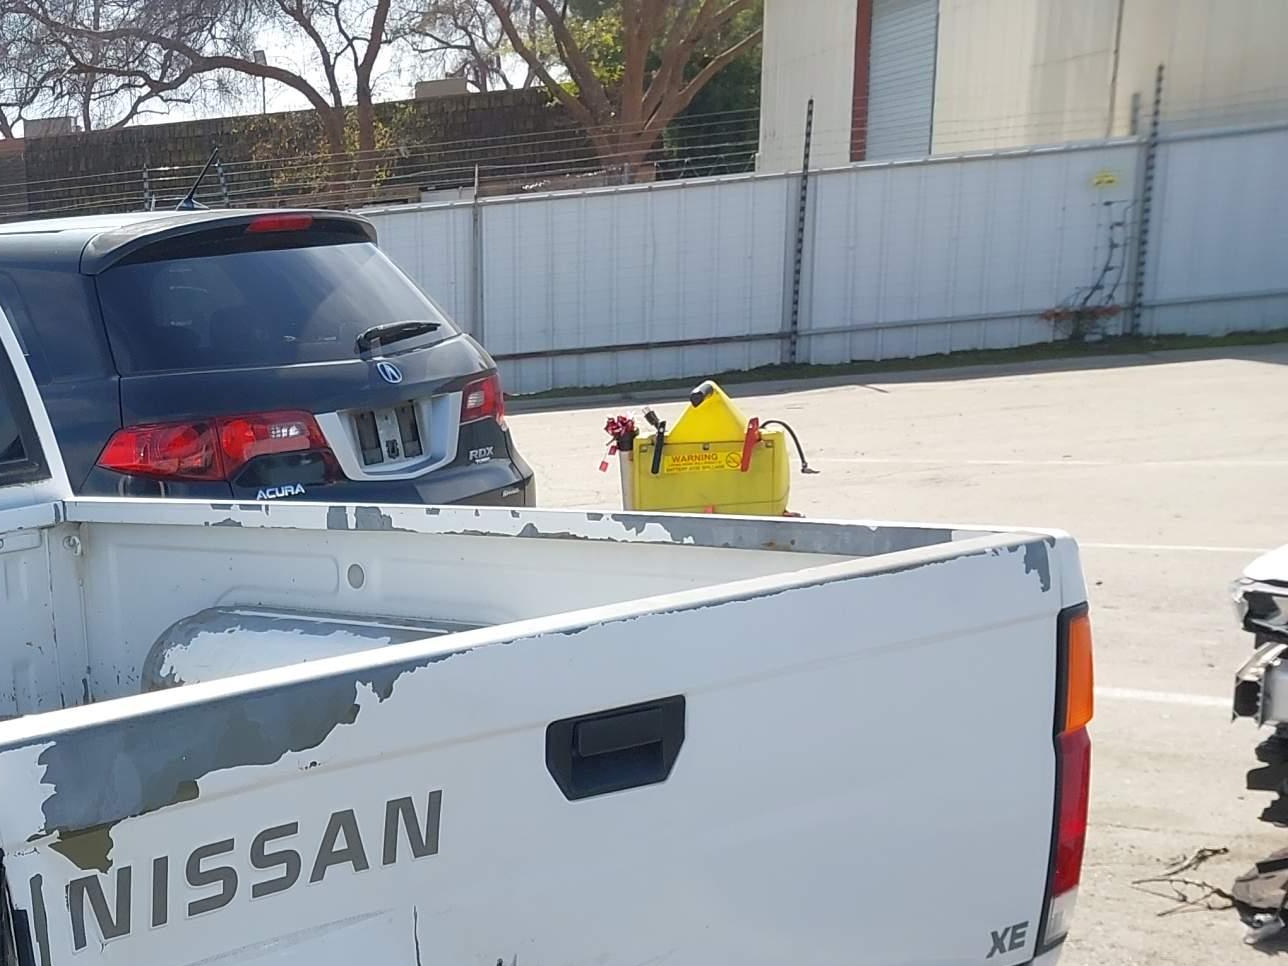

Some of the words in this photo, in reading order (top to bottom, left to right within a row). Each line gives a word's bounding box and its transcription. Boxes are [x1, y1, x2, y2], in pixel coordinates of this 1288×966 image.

[469, 446, 493, 461] RDX
[672, 453, 718, 463] WARNING
[256, 483, 306, 500] ACURA
[69, 789, 443, 951] NISSAN
[985, 920, 1029, 959] XE
